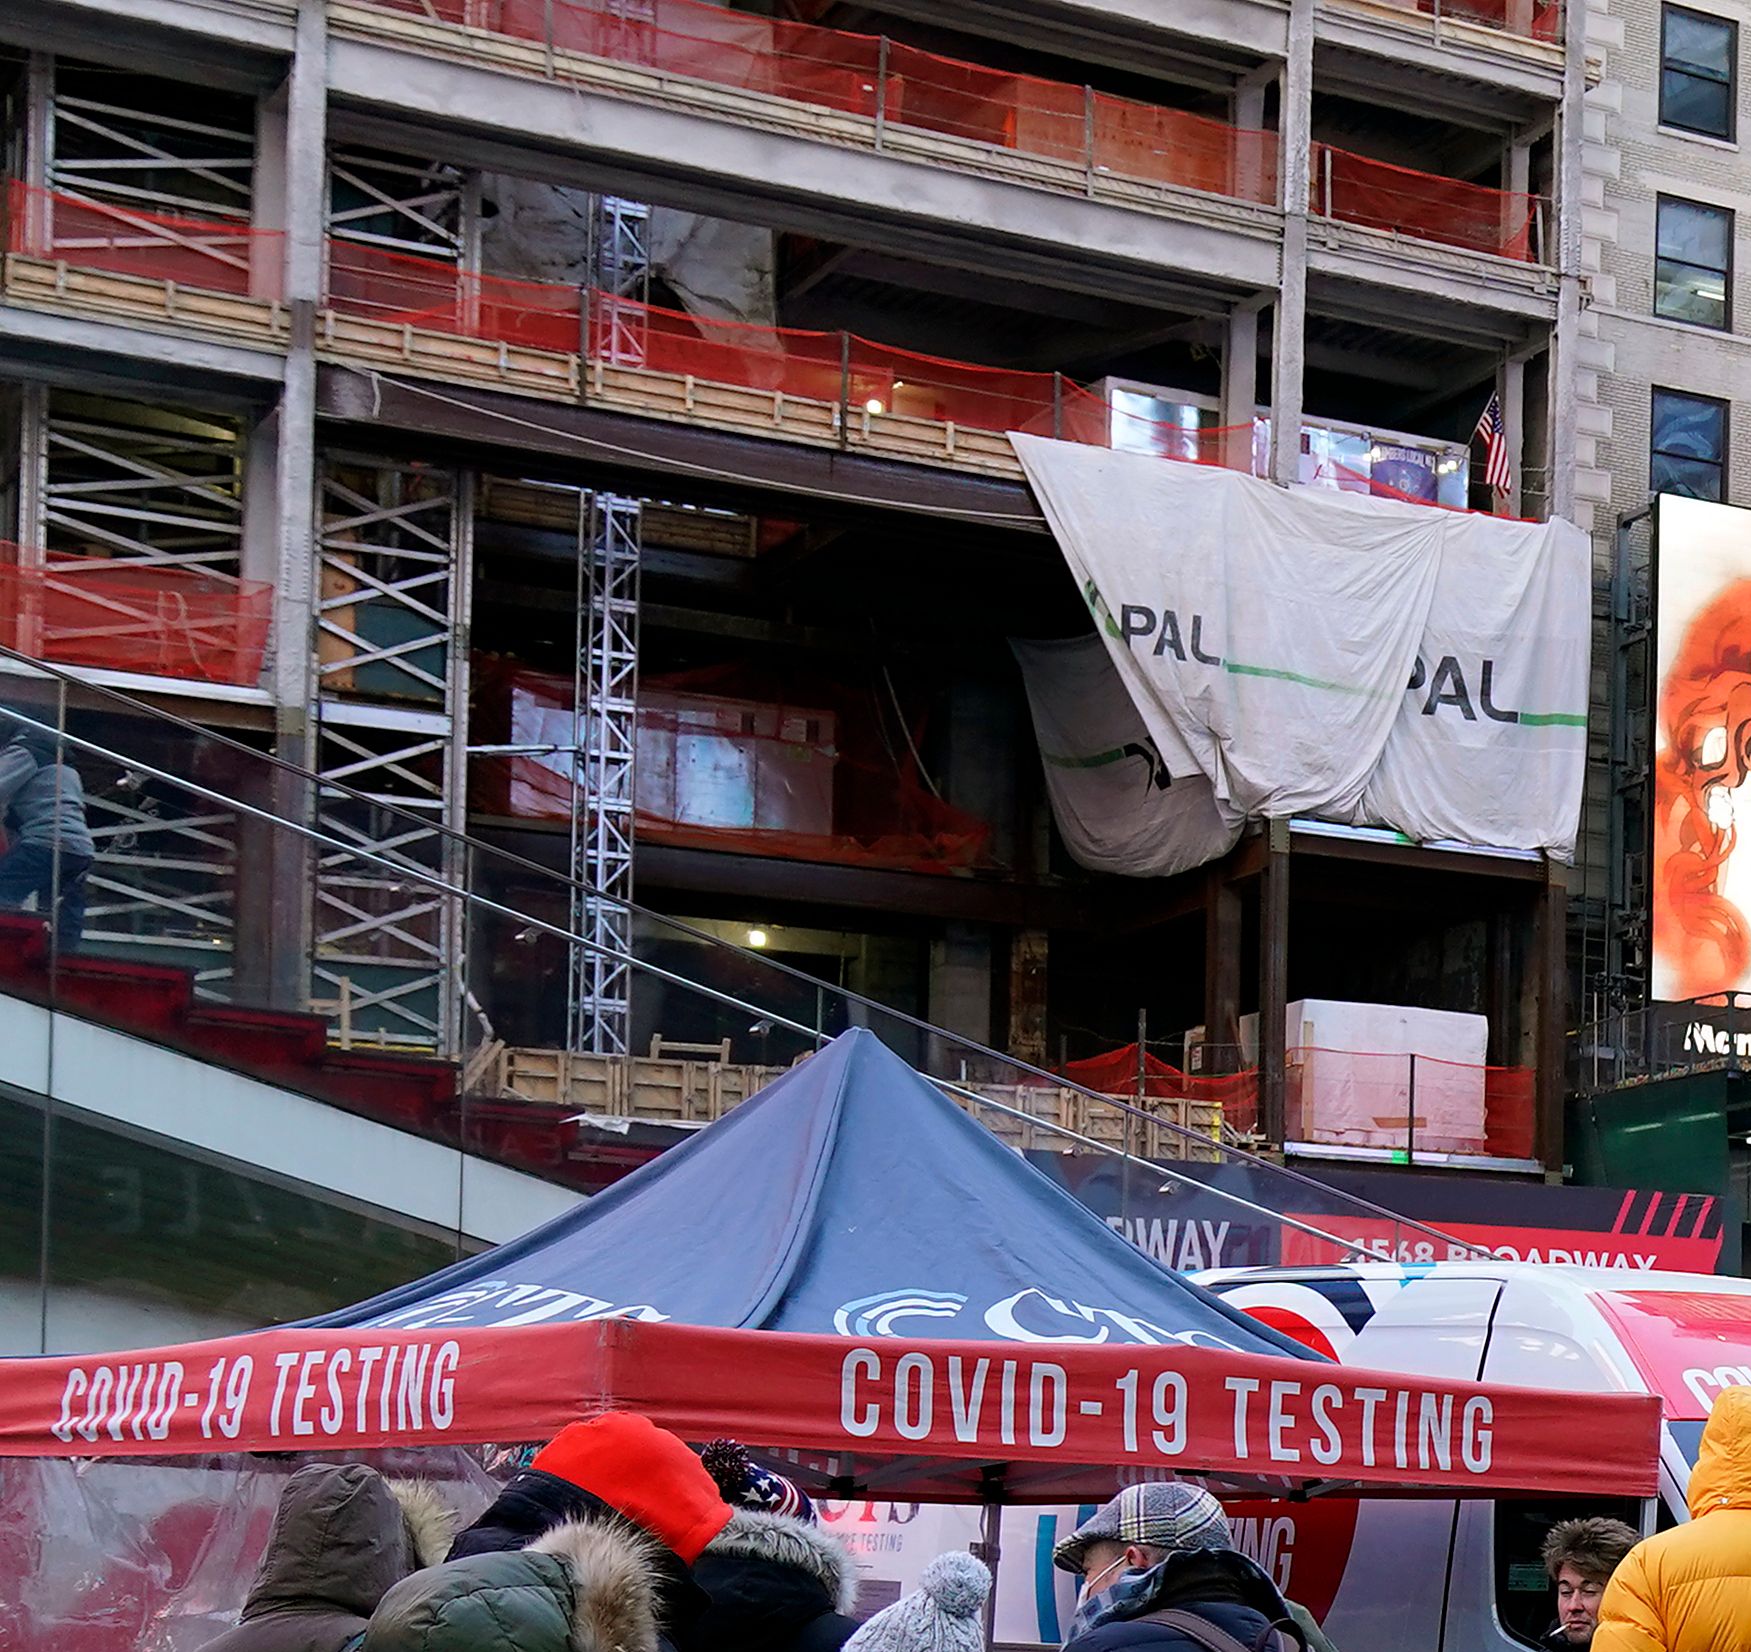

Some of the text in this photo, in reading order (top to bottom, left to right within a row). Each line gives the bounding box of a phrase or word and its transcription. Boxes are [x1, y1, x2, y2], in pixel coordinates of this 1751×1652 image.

[51, 1340, 460, 1444] COVID-19 TESTING
[840, 1347, 1494, 1474] COVID-19 TESTING
